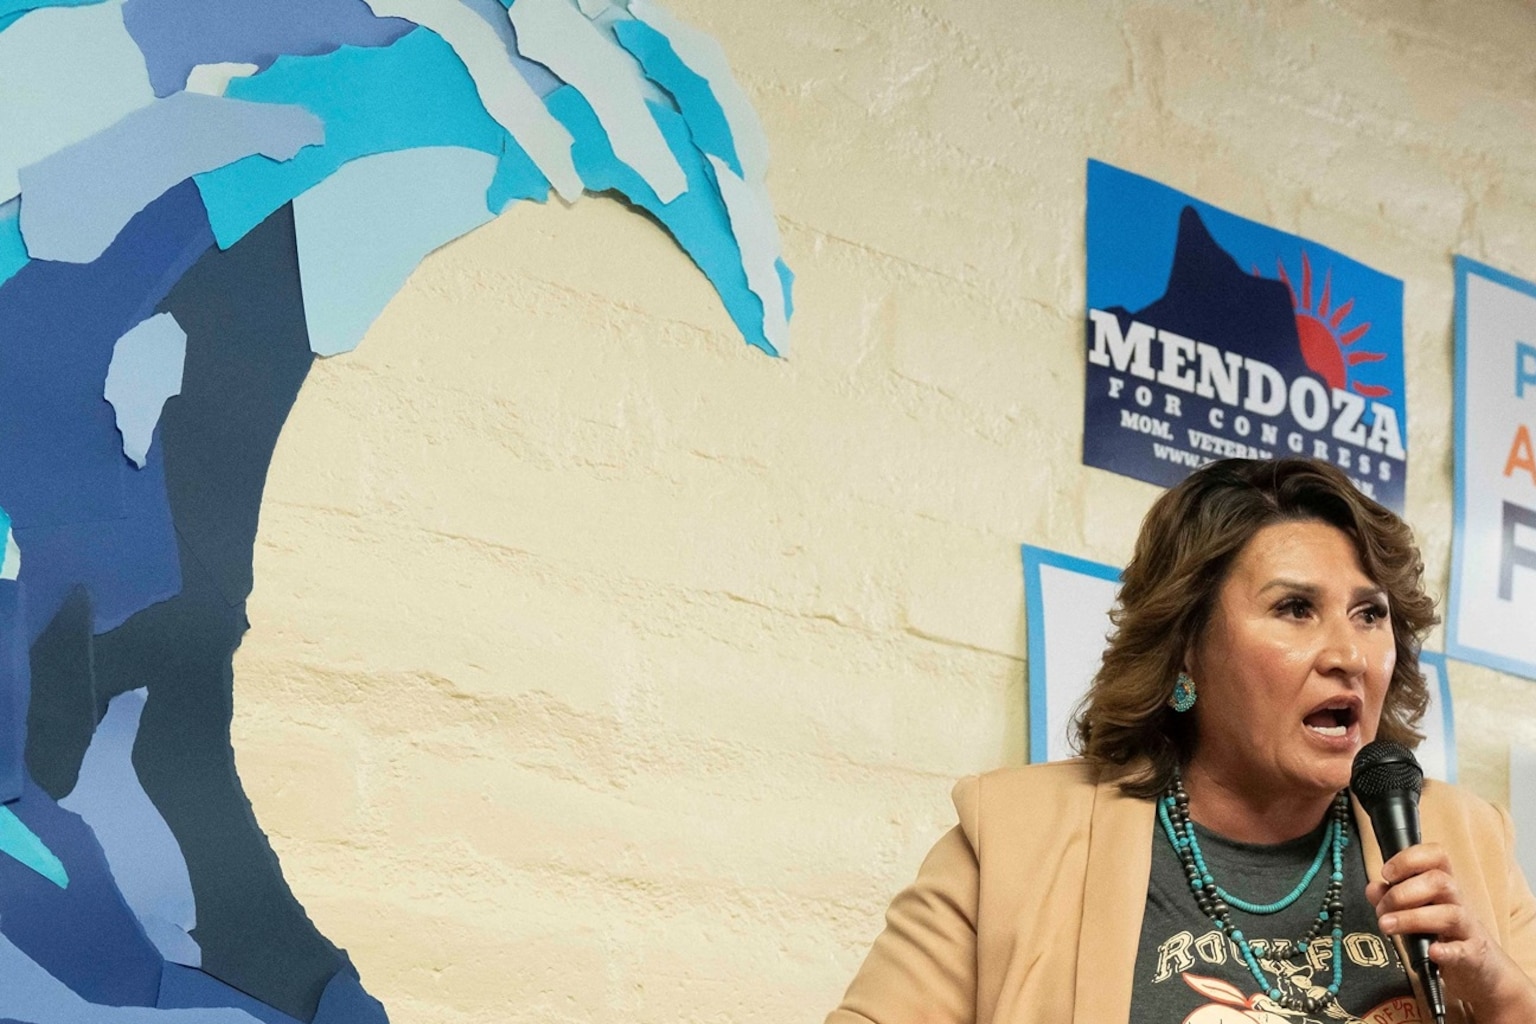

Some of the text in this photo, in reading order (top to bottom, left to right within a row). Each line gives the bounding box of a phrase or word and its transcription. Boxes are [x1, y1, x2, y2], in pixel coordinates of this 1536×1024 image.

[1088, 308, 1406, 461] MENDOZA
[1108, 376, 1182, 417] FOR
[1208, 408, 1391, 482] CONGRESS
[1120, 409, 1174, 441] MOM.
